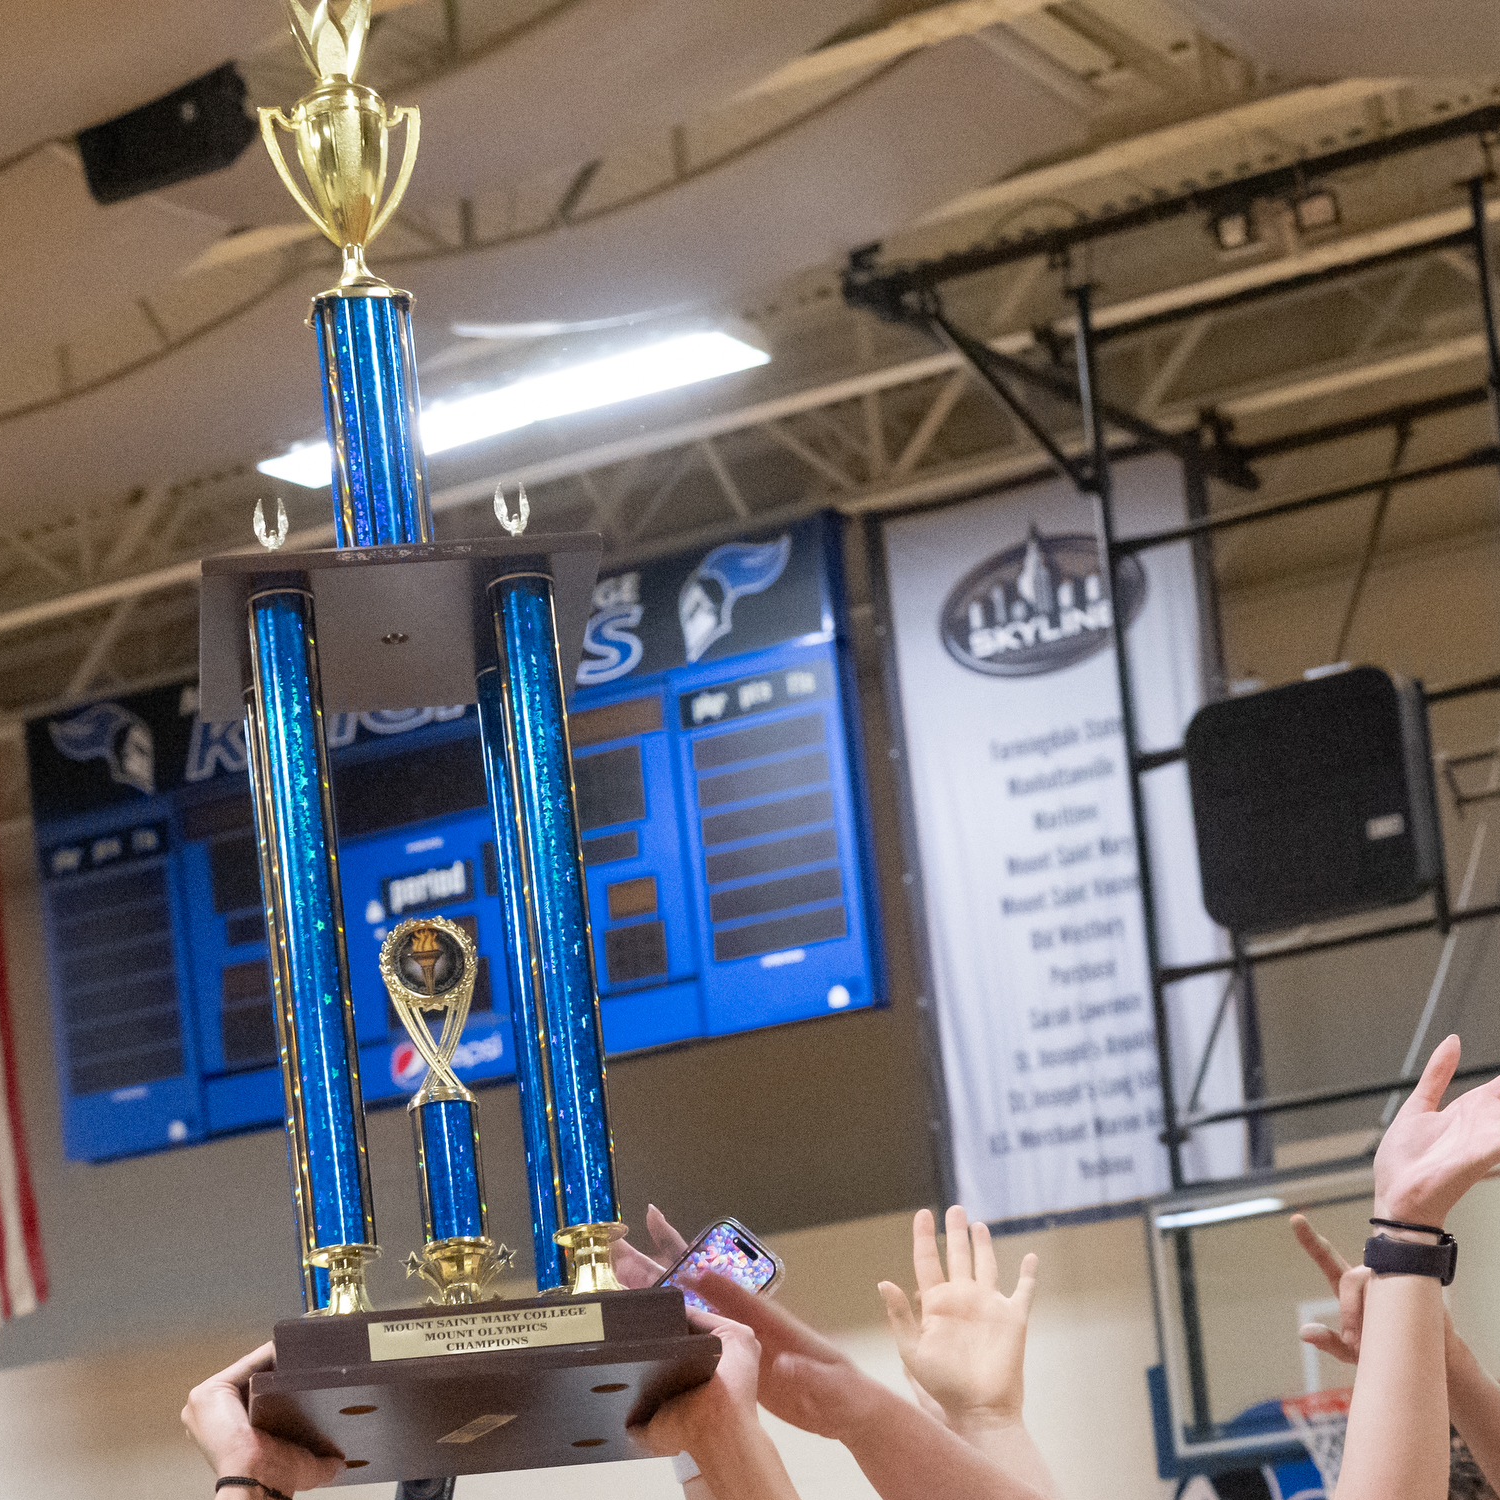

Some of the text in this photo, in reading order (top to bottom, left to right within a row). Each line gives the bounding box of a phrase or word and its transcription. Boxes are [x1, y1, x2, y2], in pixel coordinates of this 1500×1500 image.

[383, 1307, 587, 1334] MOUNT SAINT MARY COLLEGE
[424, 1322, 548, 1341] MOUNT OLYMPICS
[446, 1336, 529, 1352] CHAMPIONS
